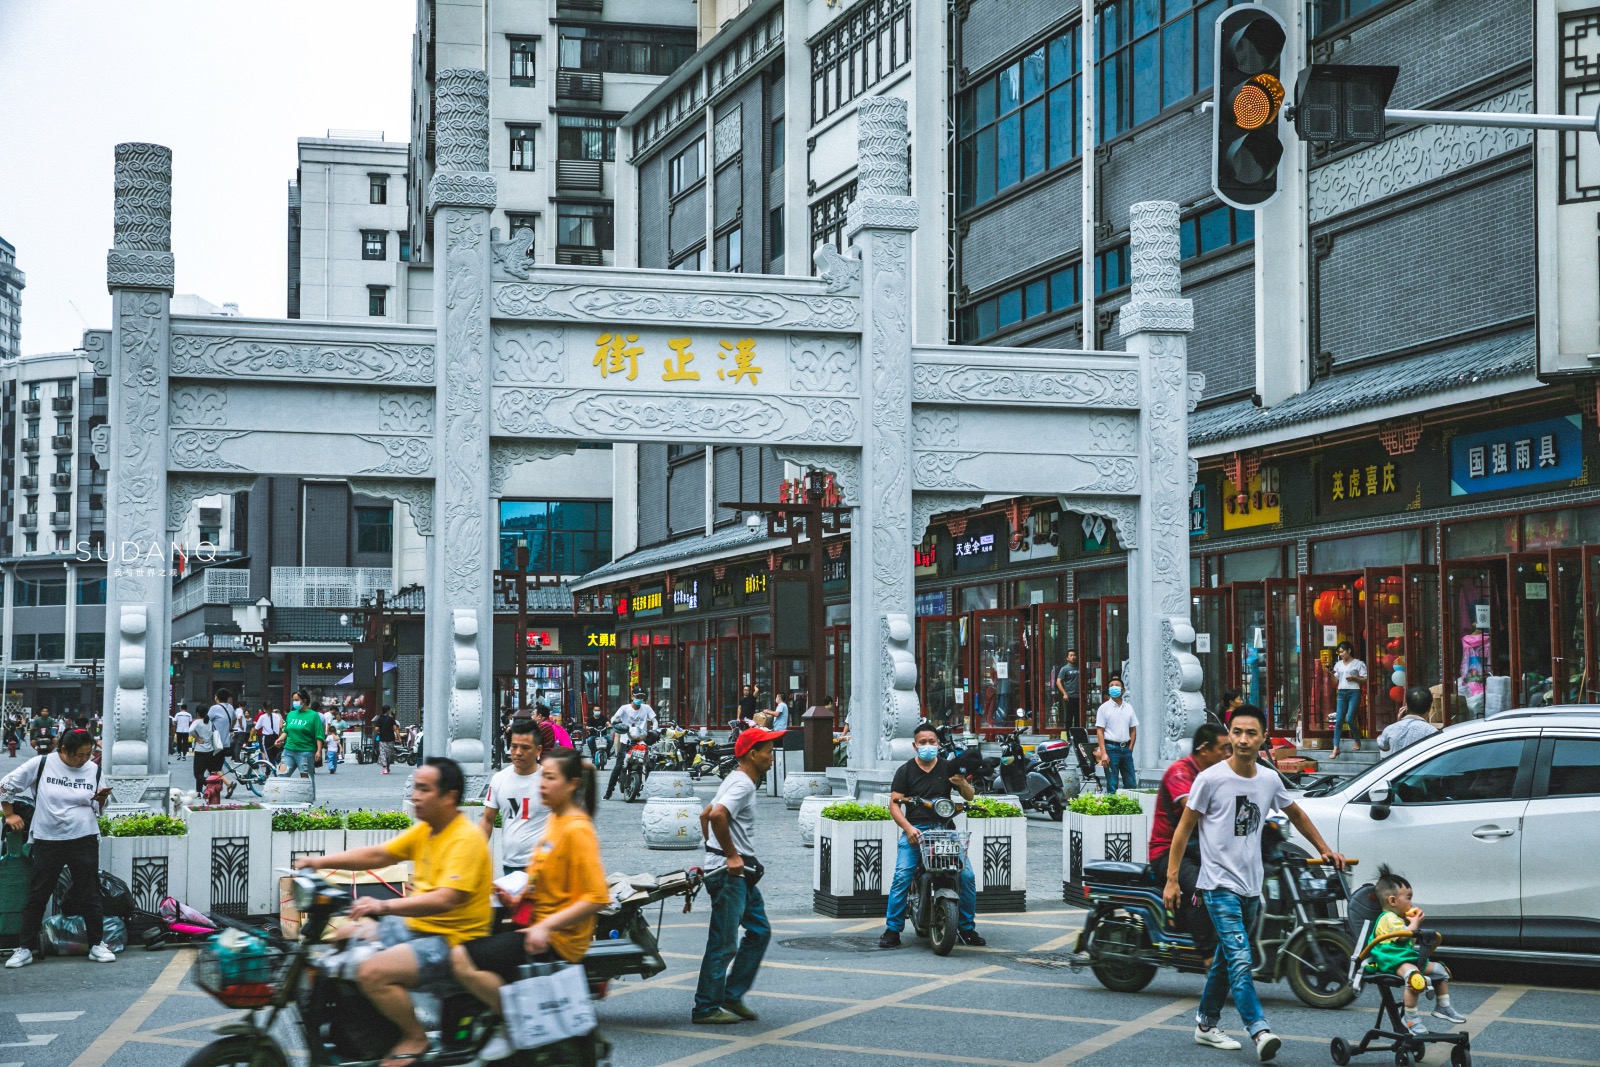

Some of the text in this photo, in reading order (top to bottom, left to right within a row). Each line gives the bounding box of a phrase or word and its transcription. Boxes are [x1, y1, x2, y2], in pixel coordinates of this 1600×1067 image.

[1469, 435, 1556, 478] 国强雨具
[1332, 462, 1396, 501] 英虎喜庆
[955, 540, 981, 556] 天堂伞
[46, 776, 69, 787] BEING
